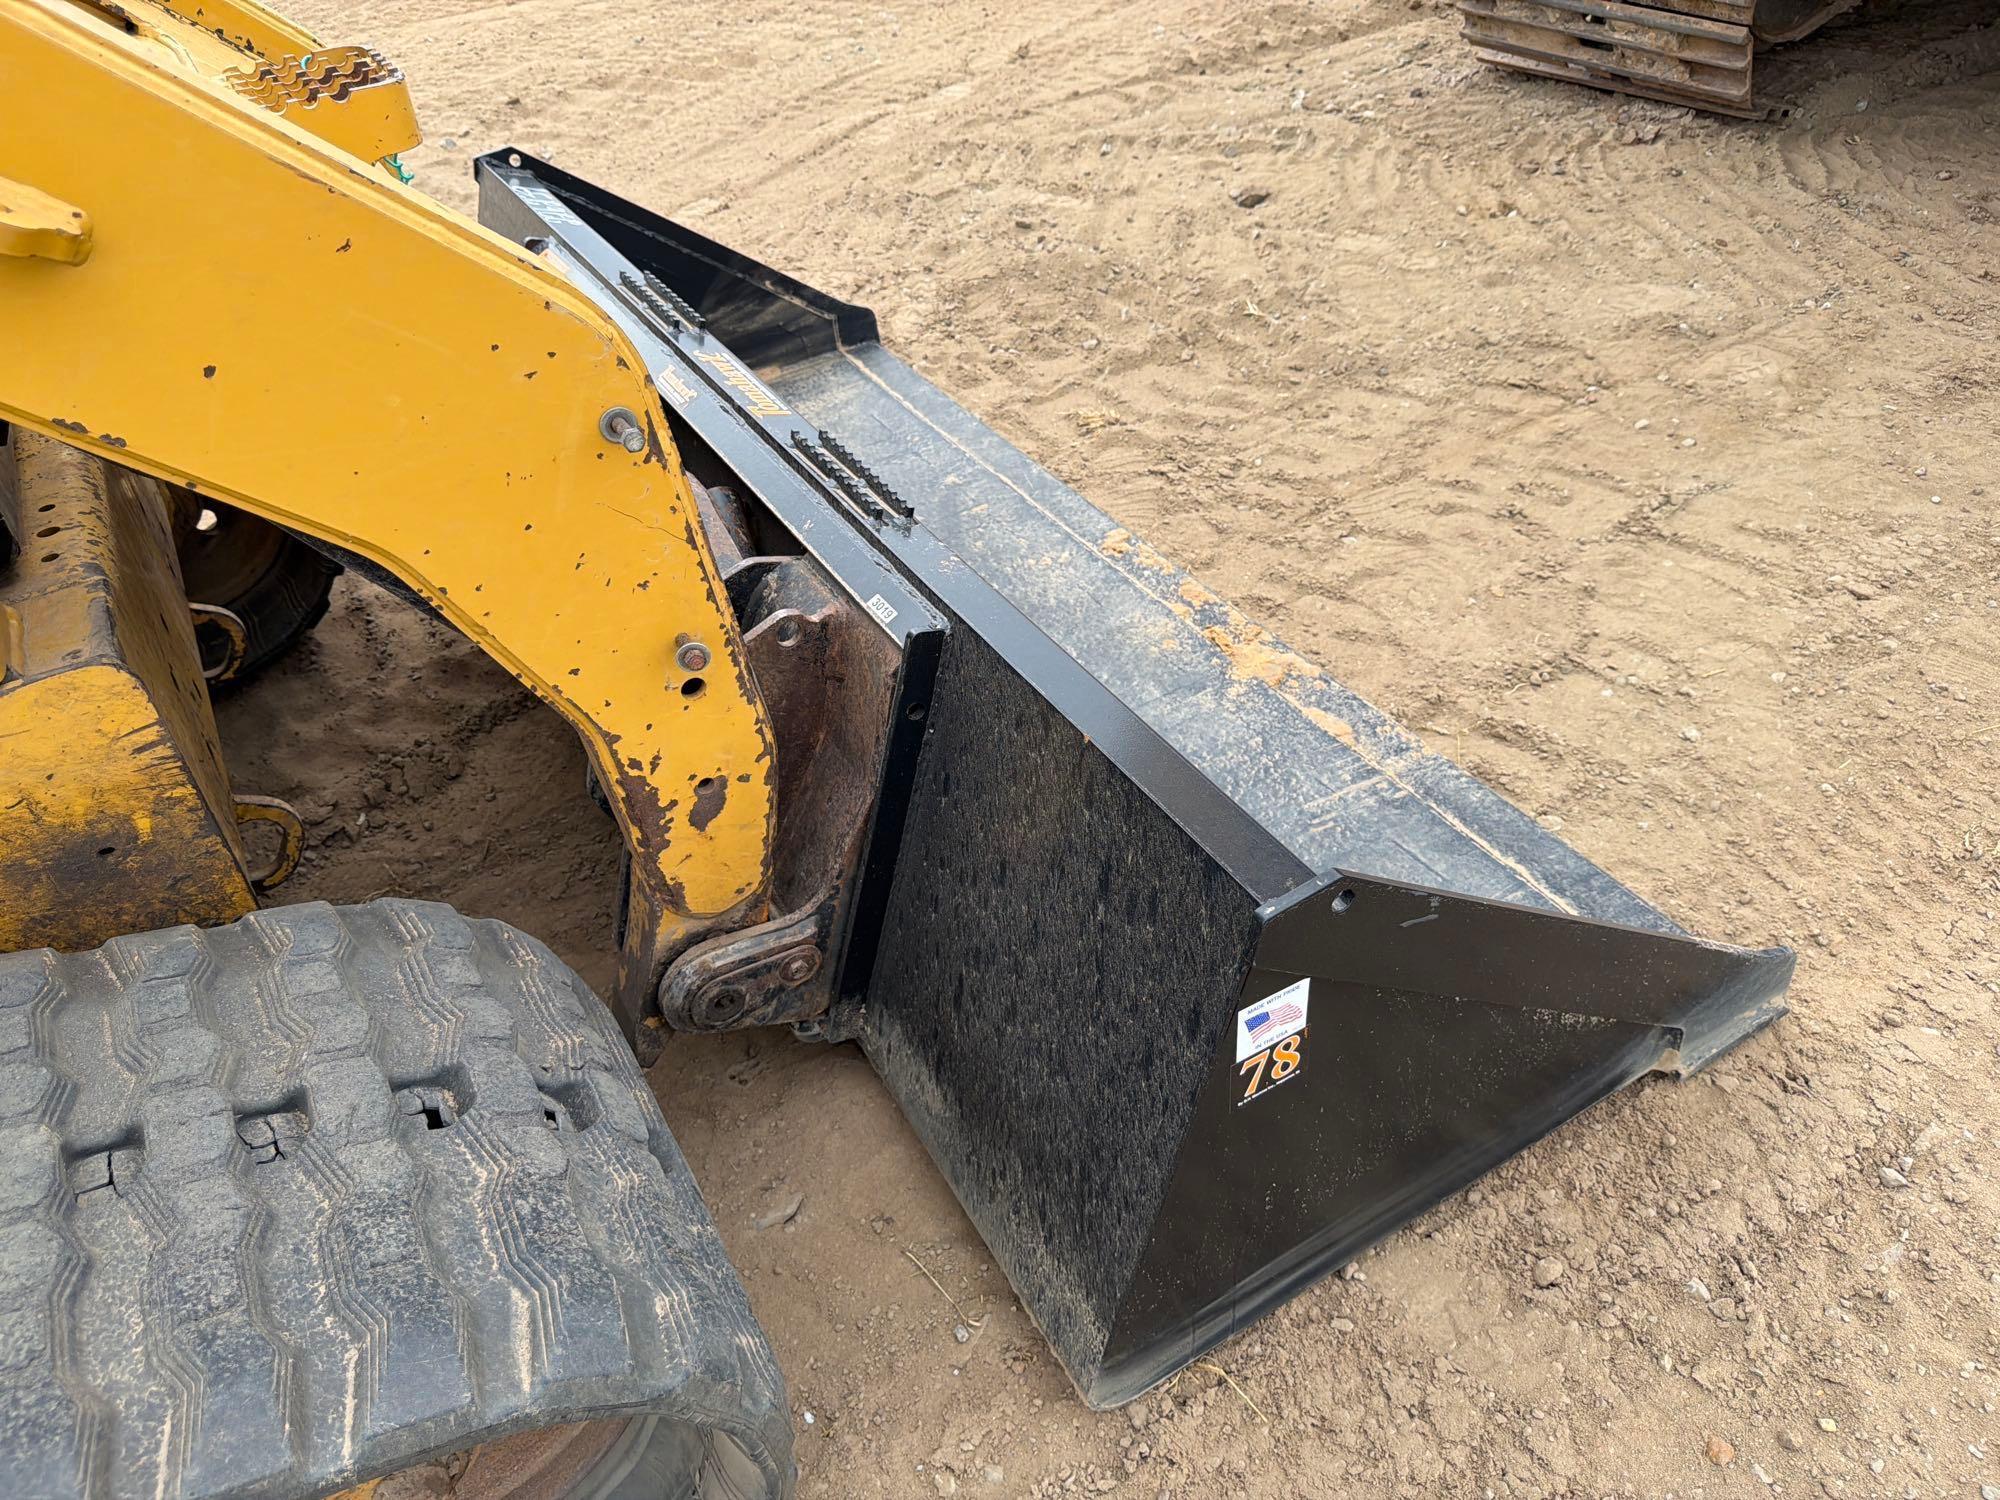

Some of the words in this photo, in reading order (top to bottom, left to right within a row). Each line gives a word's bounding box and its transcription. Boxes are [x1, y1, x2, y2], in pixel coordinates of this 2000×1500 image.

[693, 349, 792, 420] Tomahawk
[872, 598, 894, 619] 3019
[1247, 1003, 1265, 1015] MADE
[1266, 994, 1282, 1005] WITH
[1283, 985, 1301, 997] PRIDE
[1263, 1036, 1275, 1046] THE
[1276, 1029, 1288, 1040] USA
[1239, 1034, 1301, 1098] 78
